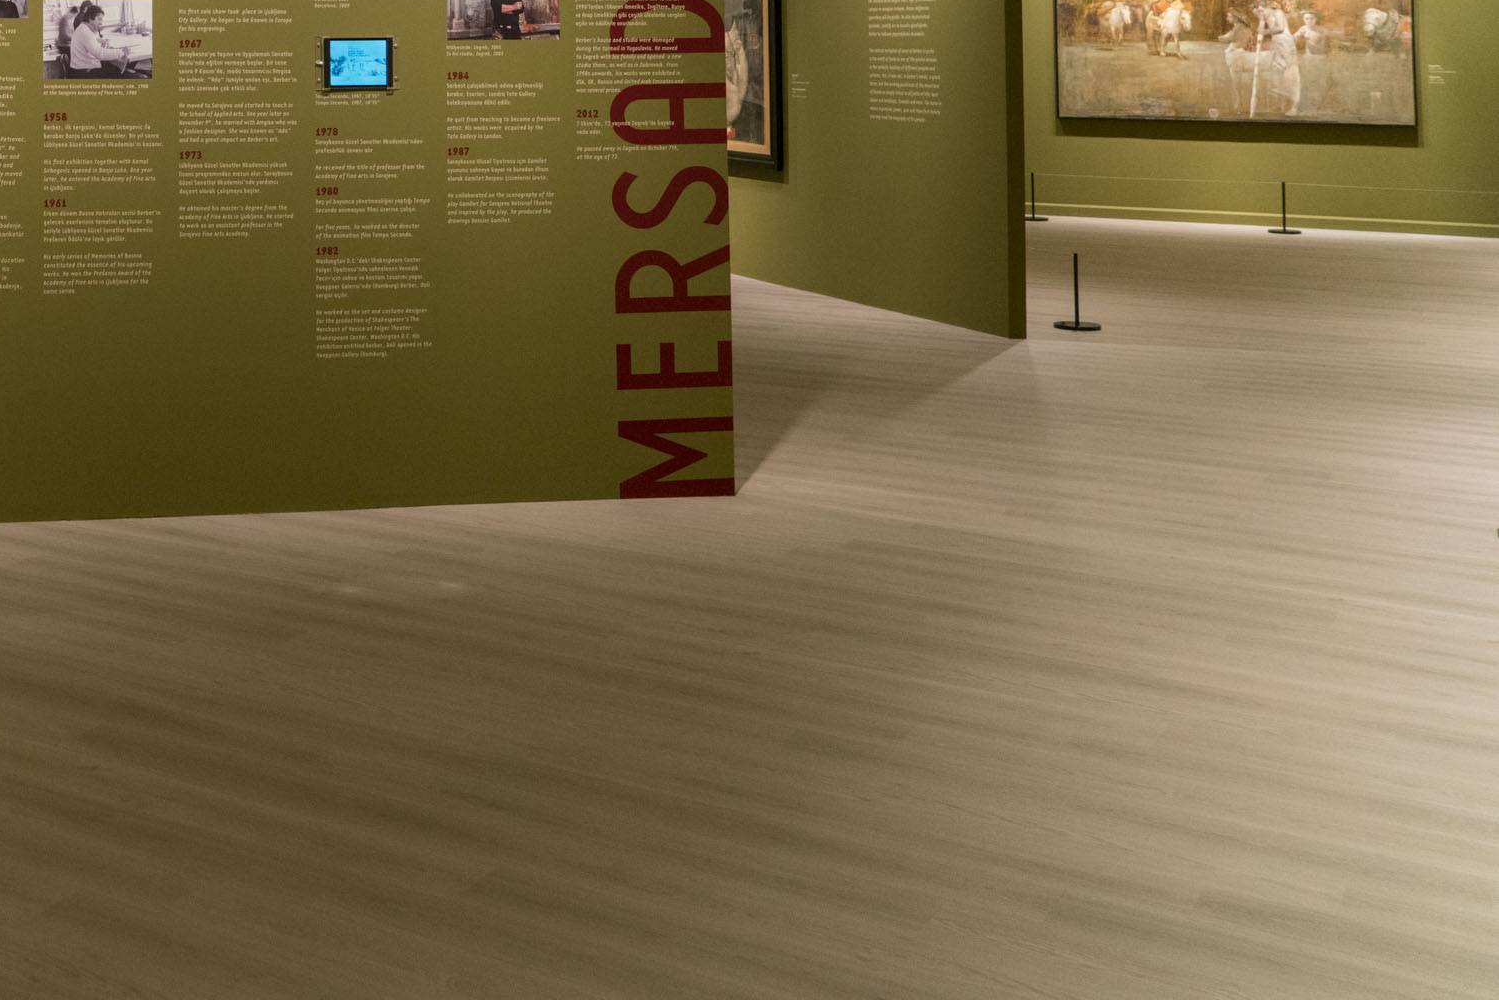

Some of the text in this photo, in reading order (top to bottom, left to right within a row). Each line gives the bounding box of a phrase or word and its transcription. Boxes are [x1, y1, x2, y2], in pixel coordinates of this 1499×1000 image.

[179, 39, 202, 48] 1967
[447, 72, 469, 80] 1984
[44, 112, 67, 121] 1958
[576, 110, 599, 118] 2012
[316, 128, 338, 136] 1978
[180, 151, 202, 160] 1973
[447, 147, 470, 156] 1987
[316, 187, 339, 195] 1980
[44, 199, 67, 208] 1961
[316, 247, 339, 255] 1982
